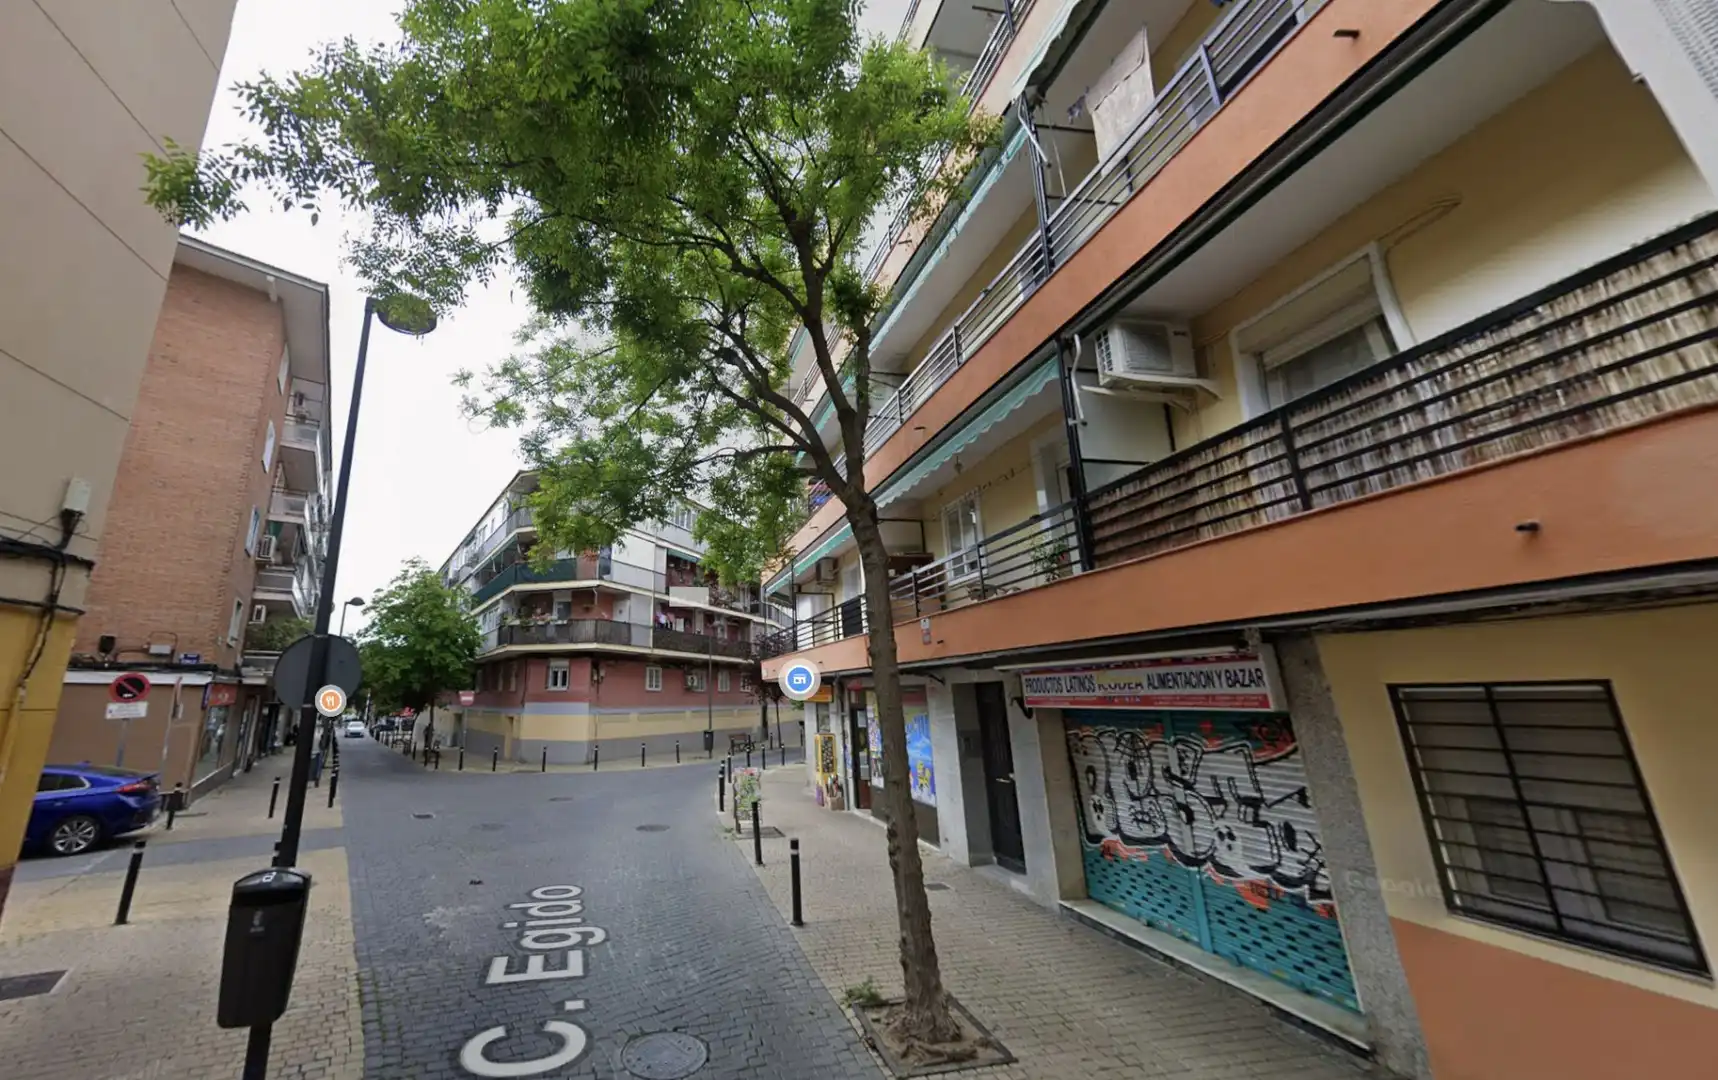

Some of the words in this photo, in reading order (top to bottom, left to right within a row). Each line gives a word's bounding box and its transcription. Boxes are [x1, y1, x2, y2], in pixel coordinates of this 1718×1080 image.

[1025, 676, 1063, 694] PRODUCTOS
[1065, 674, 1096, 693] LATINOS
[1147, 669, 1215, 690] ALIMENTACION
[1215, 669, 1223, 688] Y
[1224, 667, 1266, 687] BAZAR
